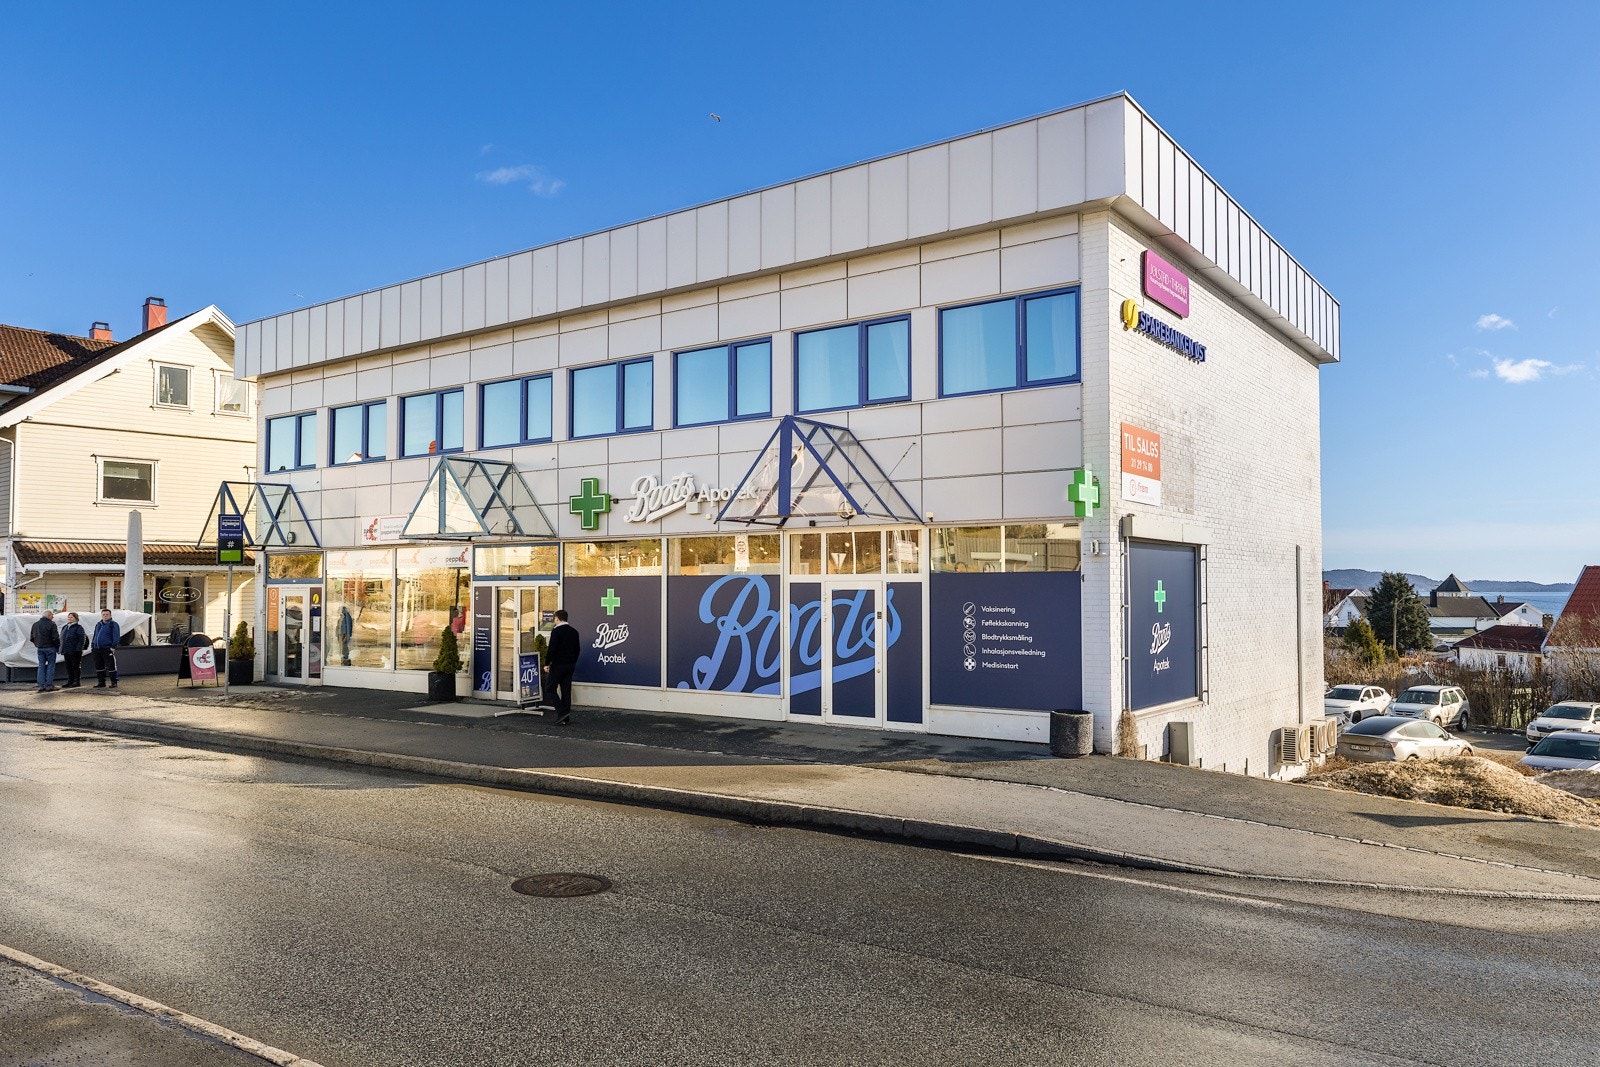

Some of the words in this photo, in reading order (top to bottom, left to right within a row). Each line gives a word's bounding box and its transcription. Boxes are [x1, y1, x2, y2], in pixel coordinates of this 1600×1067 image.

[1138, 311, 1194, 357] SPAREBANKEN
[1193, 341, 1206, 362] ØST
[1123, 432, 1136, 452] TIL
[1136, 436, 1159, 458] SALGS
[623, 471, 697, 524] Boots
[981, 605, 1016, 615] Vaksinering
[981, 619, 1029, 629] Føflekkskanning
[592, 622, 630, 650] Boots
[676, 574, 902, 696] Boots
[981, 633, 1033, 643] Blodtrykksmåling
[1149, 621, 1172, 655] Boots
[597, 652, 627, 666] Apotek
[981, 647, 1046, 658] Inhalasjonsveiledning
[981, 661, 1019, 670] Medisinstart
[1153, 657, 1171, 675] Apotek
[520, 667, 539, 684] 40%
